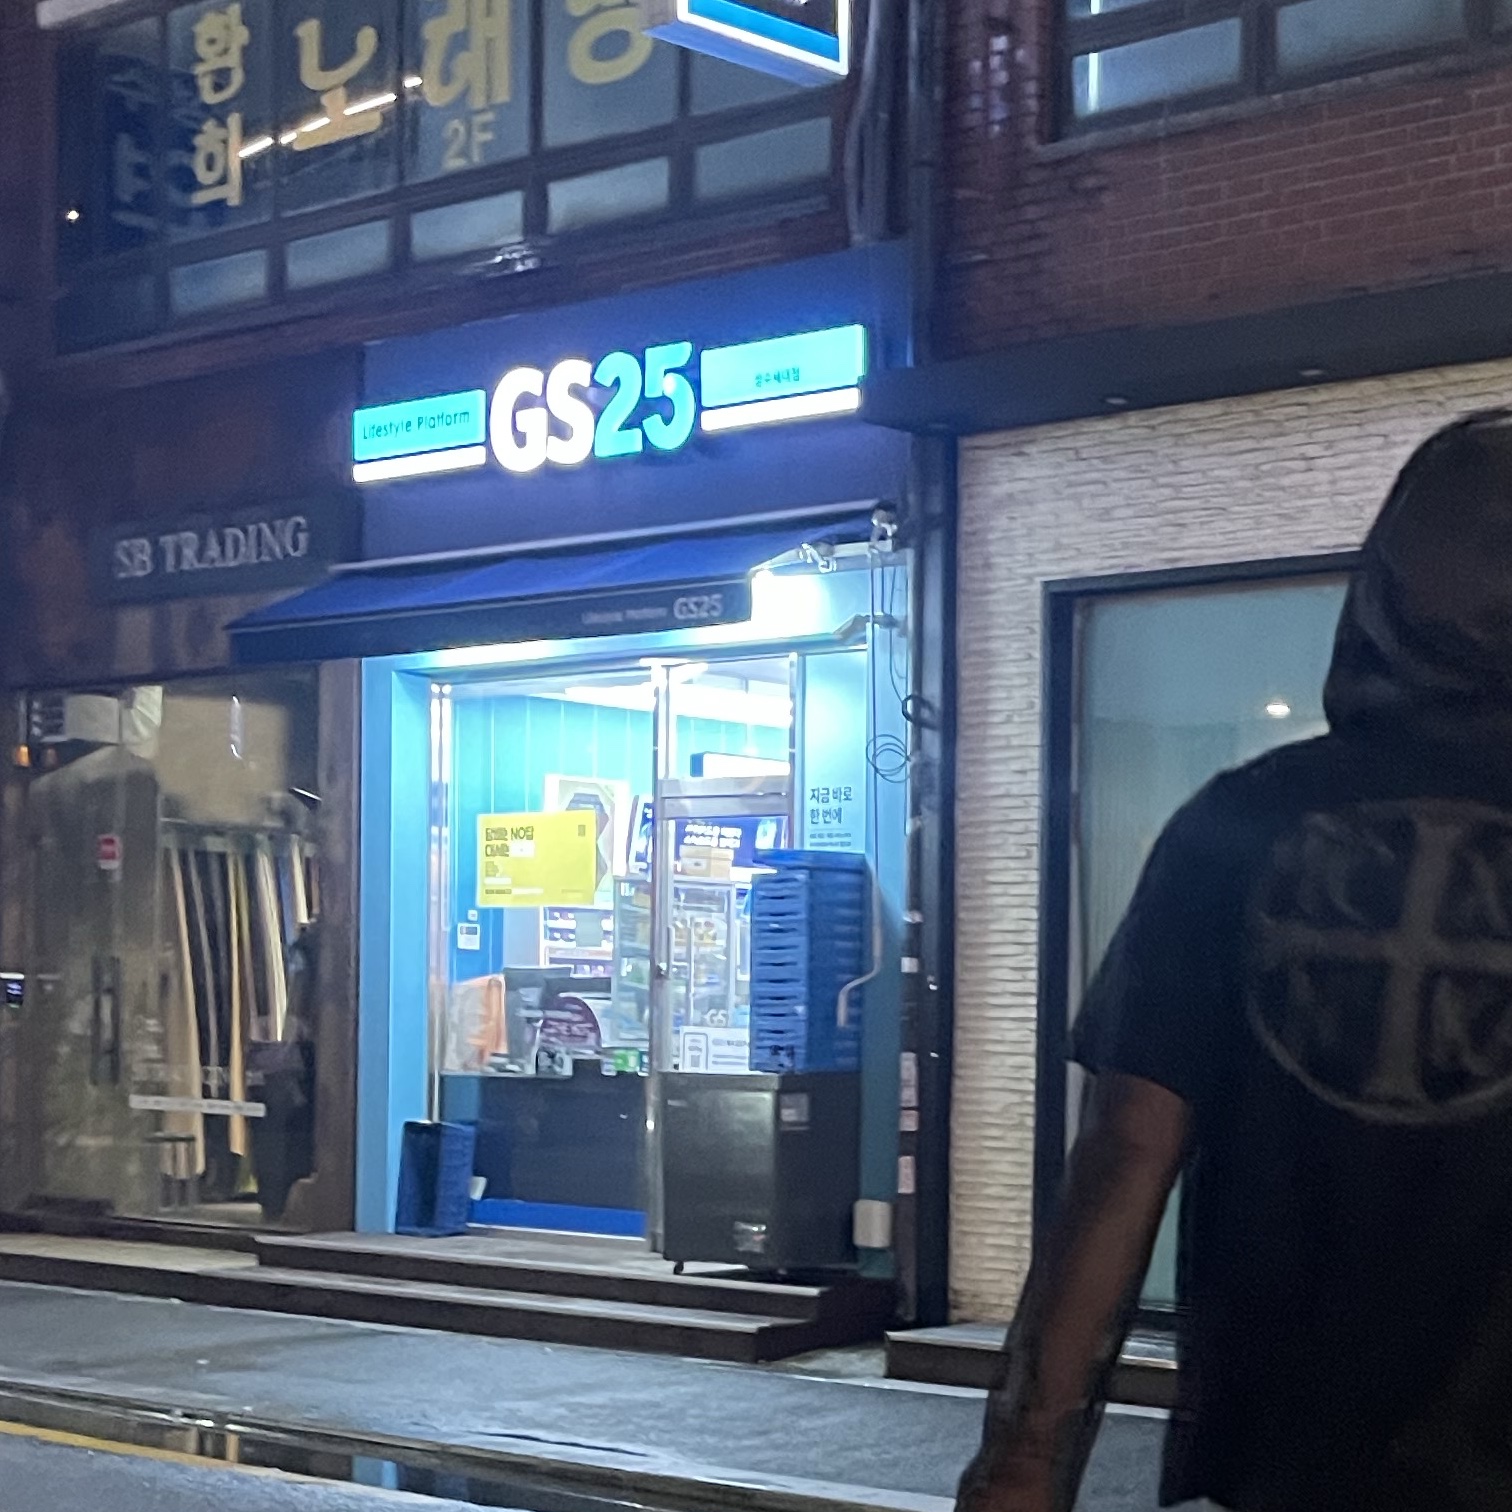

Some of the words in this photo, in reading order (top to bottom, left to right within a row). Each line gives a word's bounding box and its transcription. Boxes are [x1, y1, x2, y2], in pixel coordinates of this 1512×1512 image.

[442, 111, 496, 171] 2F
[488, 339, 698, 474] GS25
[362, 419, 412, 440] Lifestyle
[417, 411, 470, 430] Platform
[158, 515, 309, 574] TRADING
[673, 593, 724, 620] GS25
[809, 786, 830, 804] 지금
[832, 785, 853, 803] 바로
[809, 807, 820, 825] 한
